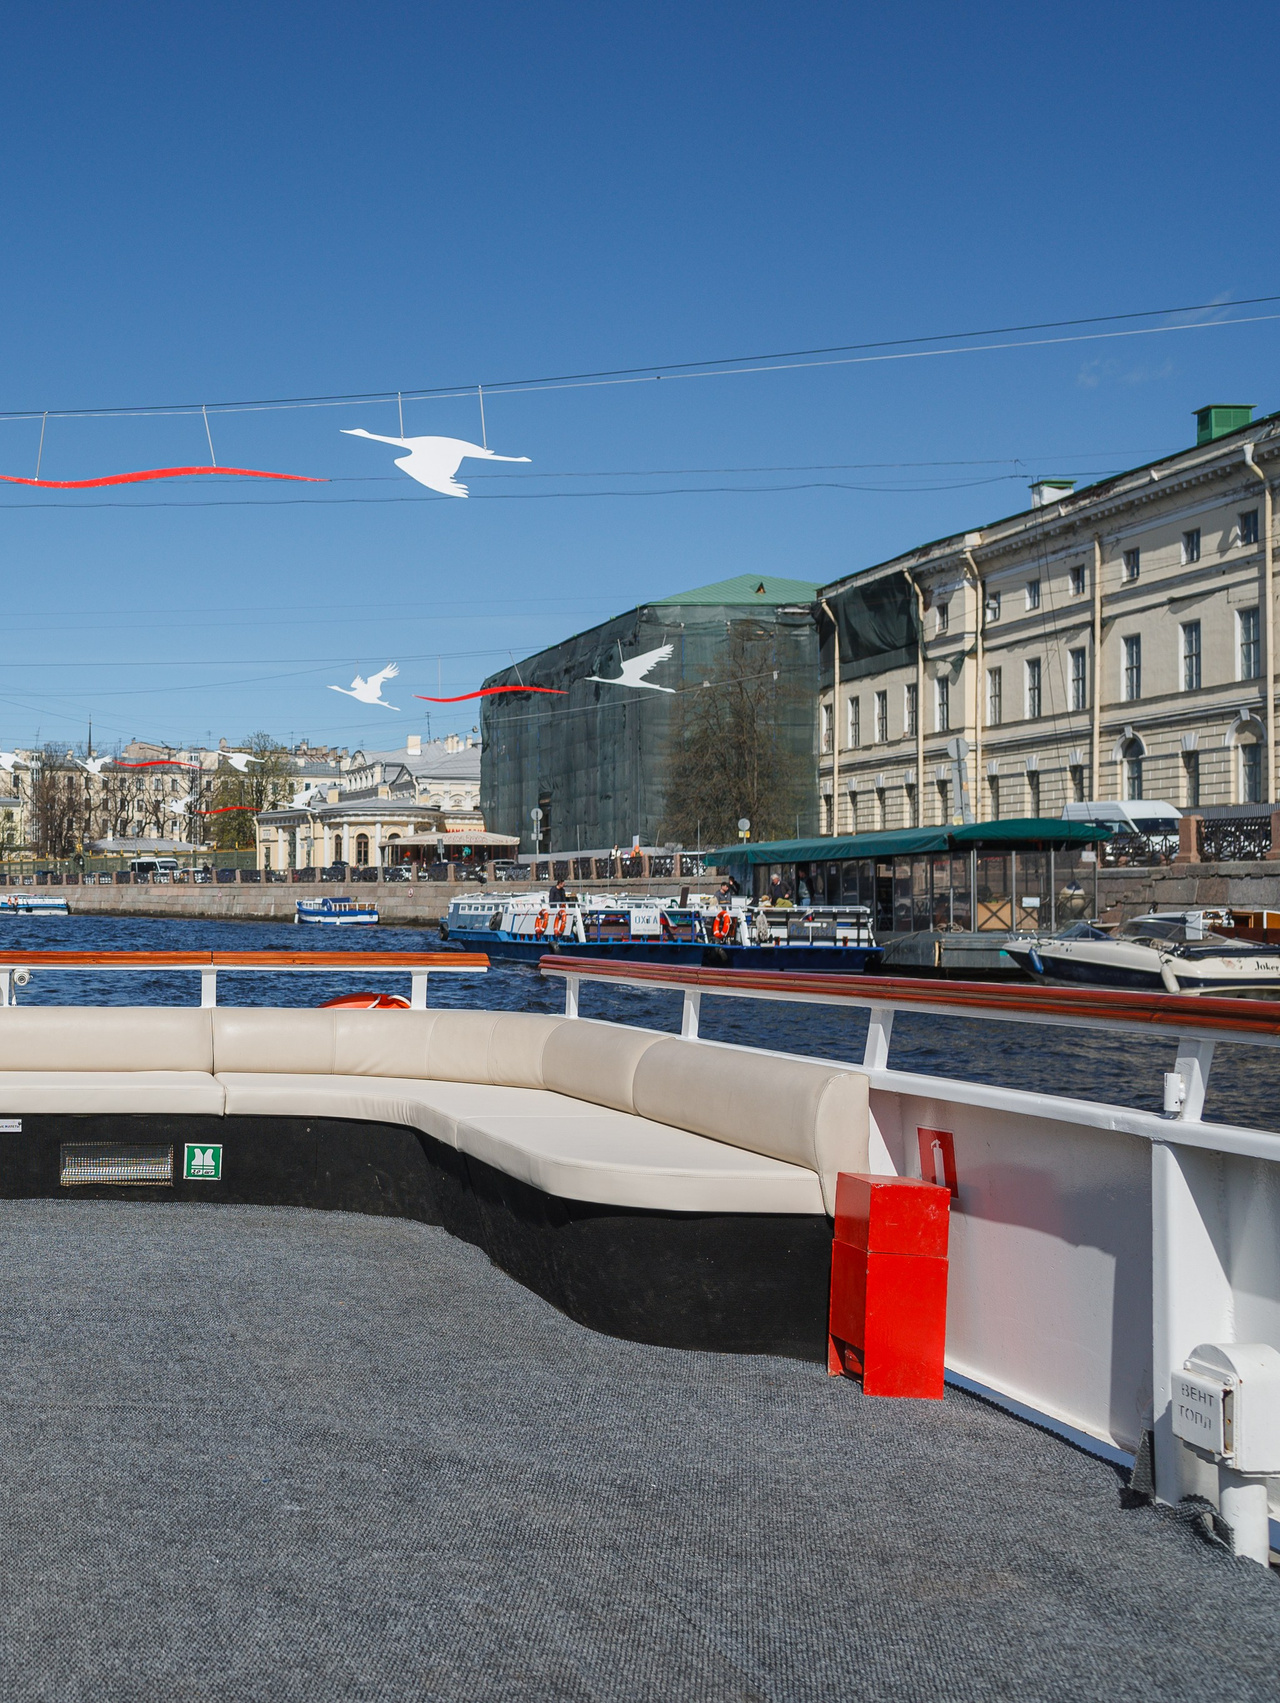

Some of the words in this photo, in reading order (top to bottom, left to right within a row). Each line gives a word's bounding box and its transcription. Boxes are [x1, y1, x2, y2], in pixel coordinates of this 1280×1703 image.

[634, 915, 658, 925] ОХТА
[1254, 960, 1280, 972] Joker
[1181, 1383, 1214, 1407] ВЕНТ
[1178, 1403, 1212, 1430] ТОПЛ
